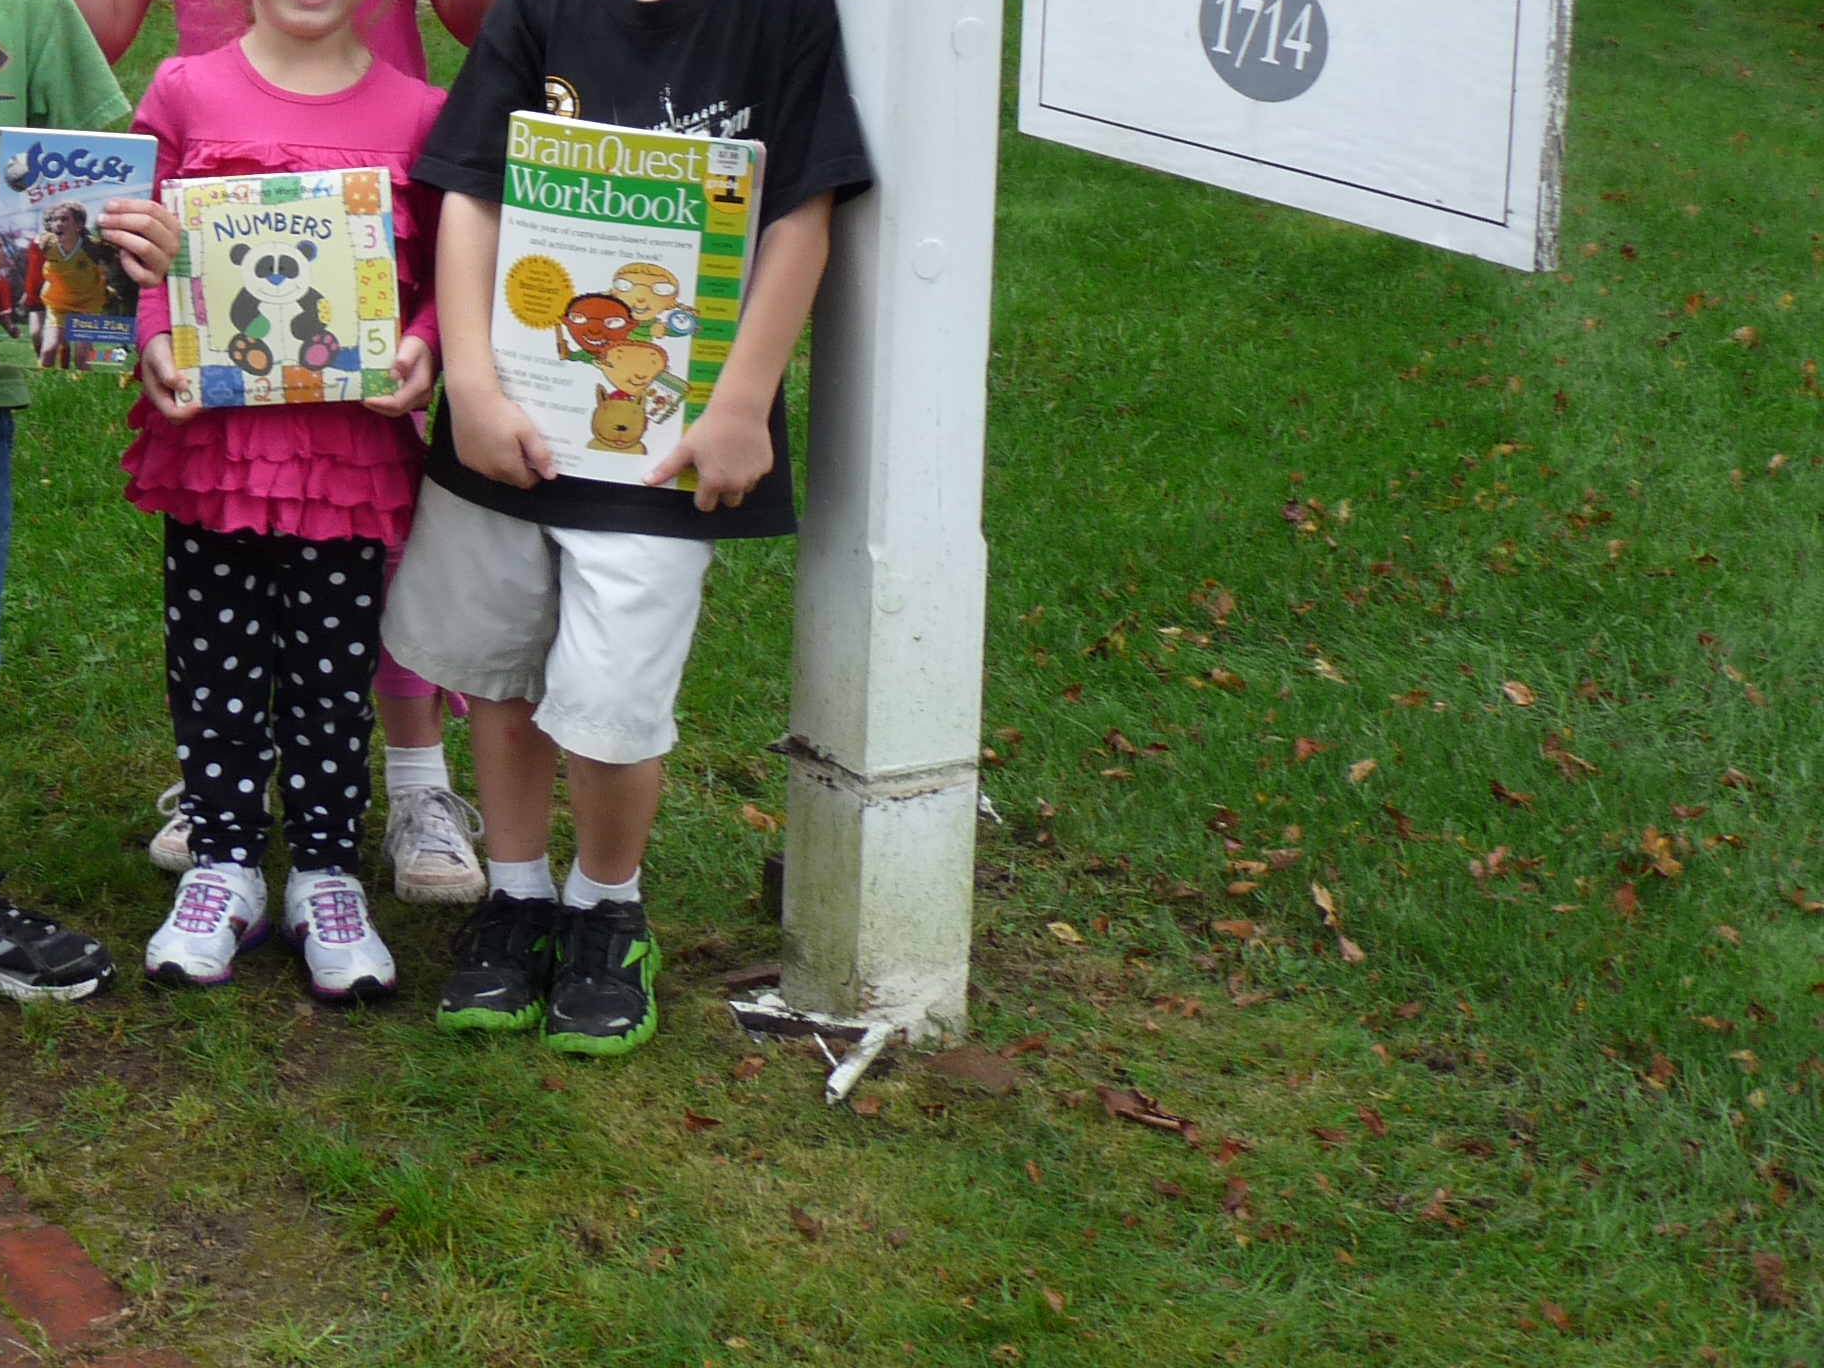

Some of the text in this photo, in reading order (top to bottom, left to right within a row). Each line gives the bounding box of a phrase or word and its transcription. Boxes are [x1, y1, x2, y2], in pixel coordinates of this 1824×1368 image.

[26, 140, 135, 189] Soccer
[508, 164, 701, 226] Workbook
[213, 211, 334, 243] NUMBERS
[363, 224, 377, 249] 3
[367, 329, 387, 355] 5
[335, 376, 350, 401] 7
